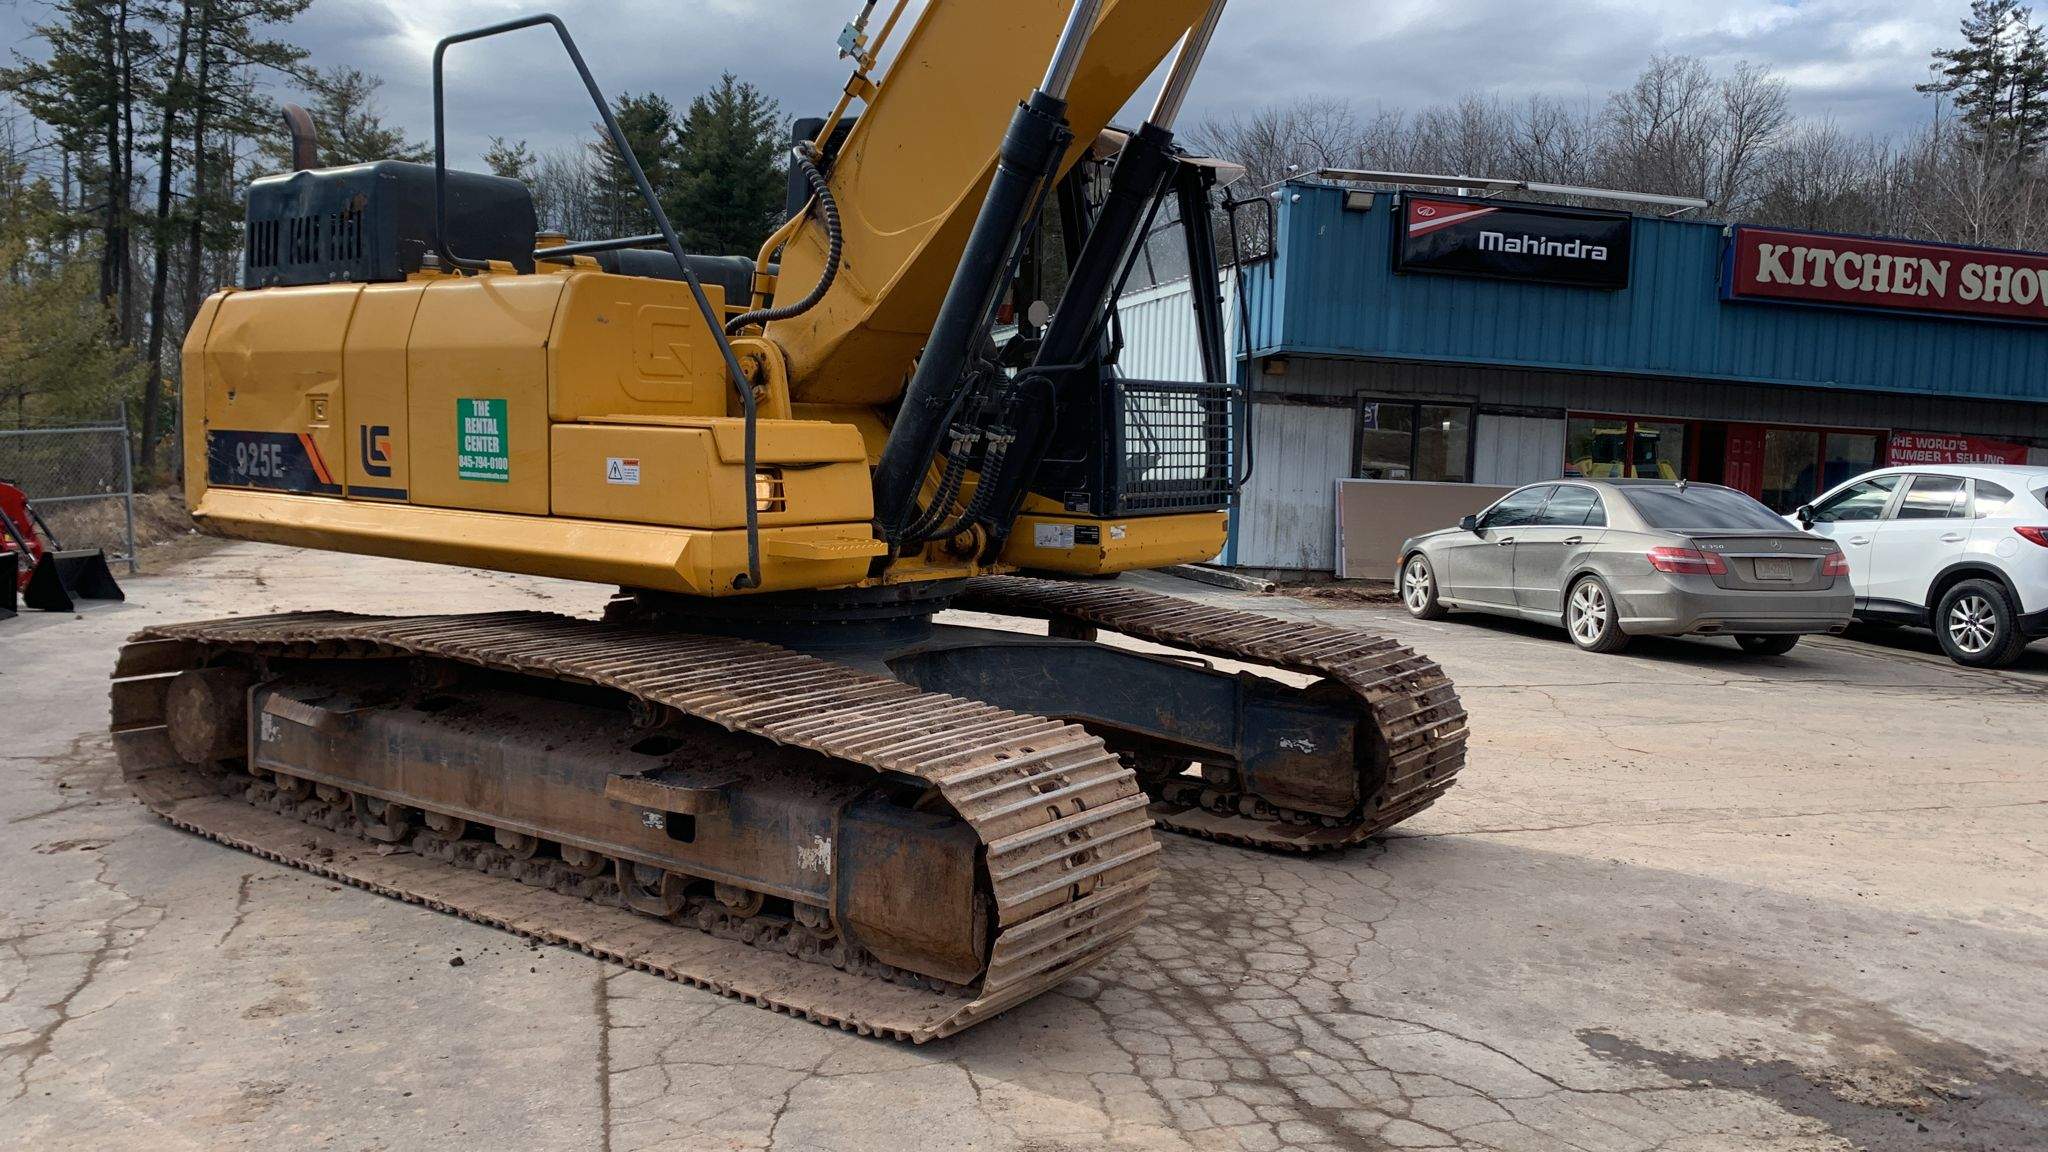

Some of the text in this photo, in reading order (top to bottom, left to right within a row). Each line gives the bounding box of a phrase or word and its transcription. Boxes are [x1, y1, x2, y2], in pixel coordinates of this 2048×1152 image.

[1479, 230, 1608, 261] Mahindra
[1755, 243, 1951, 299] KITCHEN
[472, 400, 490, 417] THE
[464, 417, 499, 435] RENTAL
[464, 435, 500, 453] CENTER
[1891, 436, 1968, 450] THE WORLD'S
[235, 441, 284, 478] 925E
[1891, 449, 2005, 464] NUMBER 1 SELLING
